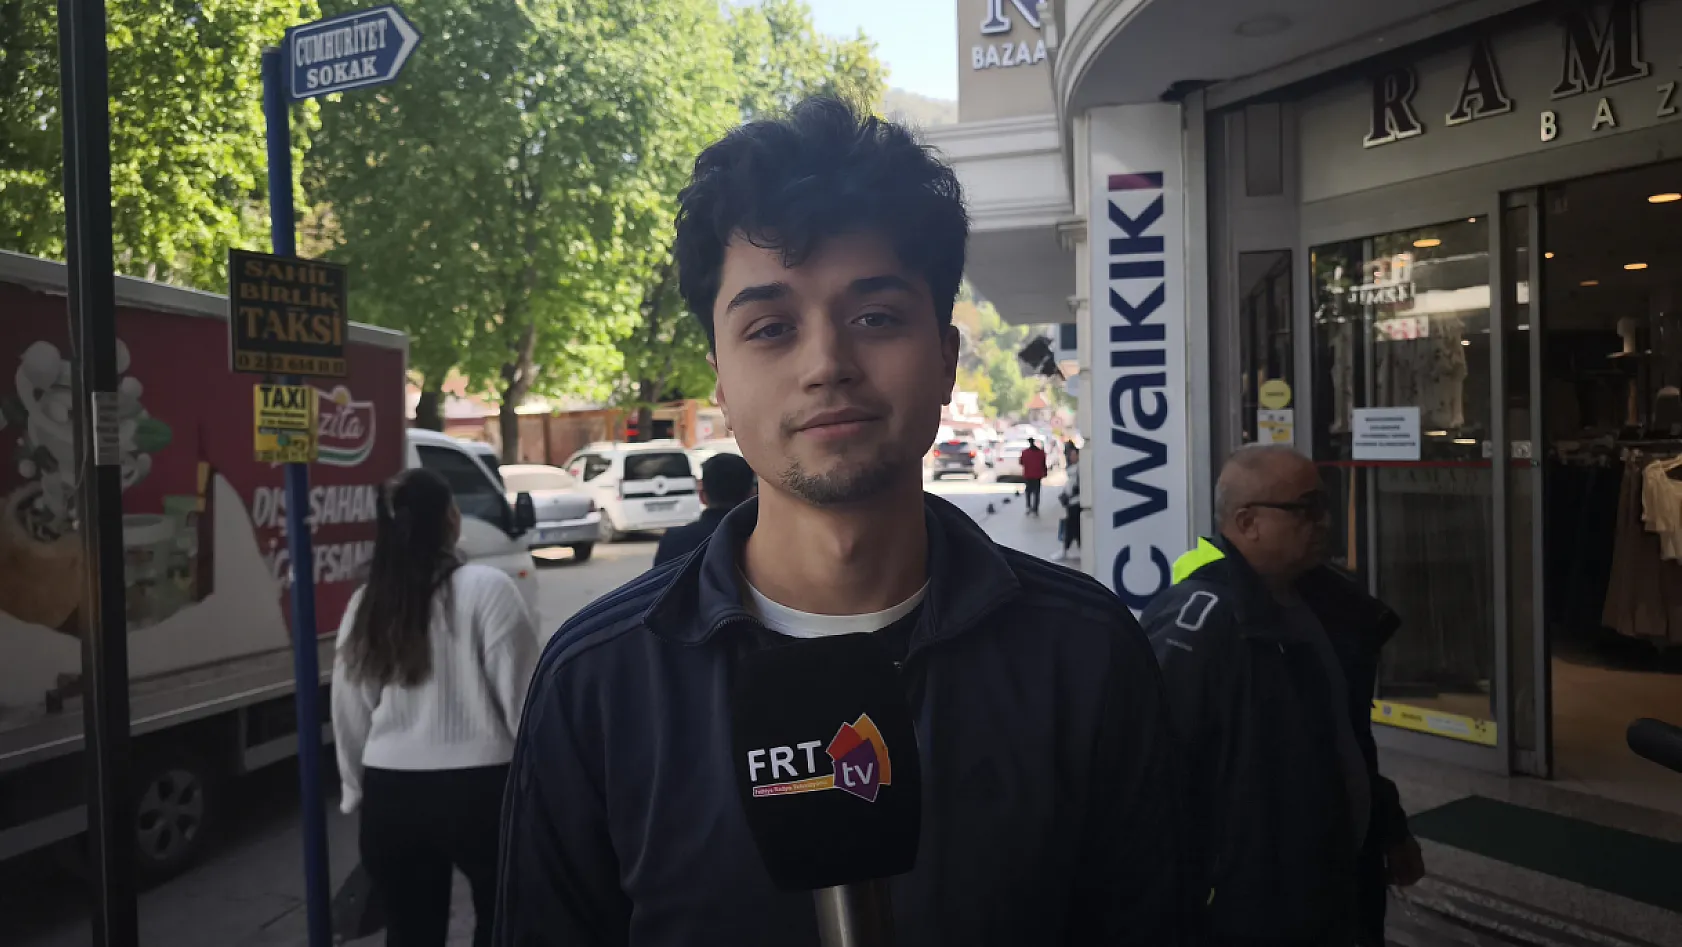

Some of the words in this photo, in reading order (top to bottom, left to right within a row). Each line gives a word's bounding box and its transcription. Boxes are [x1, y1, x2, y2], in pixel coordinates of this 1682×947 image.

[295, 18, 388, 67] CUMHURİYET
[971, 39, 1047, 70] BAZAA
[306, 55, 378, 89] SOKAK
[1362, 0, 1651, 148] RAM
[1540, 81, 1678, 142] BAZ
[244, 259, 336, 286] SAHİL
[239, 280, 340, 309] BİRLİK
[239, 305, 342, 346] TAKSİ
[259, 384, 306, 409] TAXI
[317, 405, 366, 440] zita
[305, 485, 377, 535] ŞAHAN
[747, 740, 822, 782] FRT
[841, 762, 875, 788] tv
